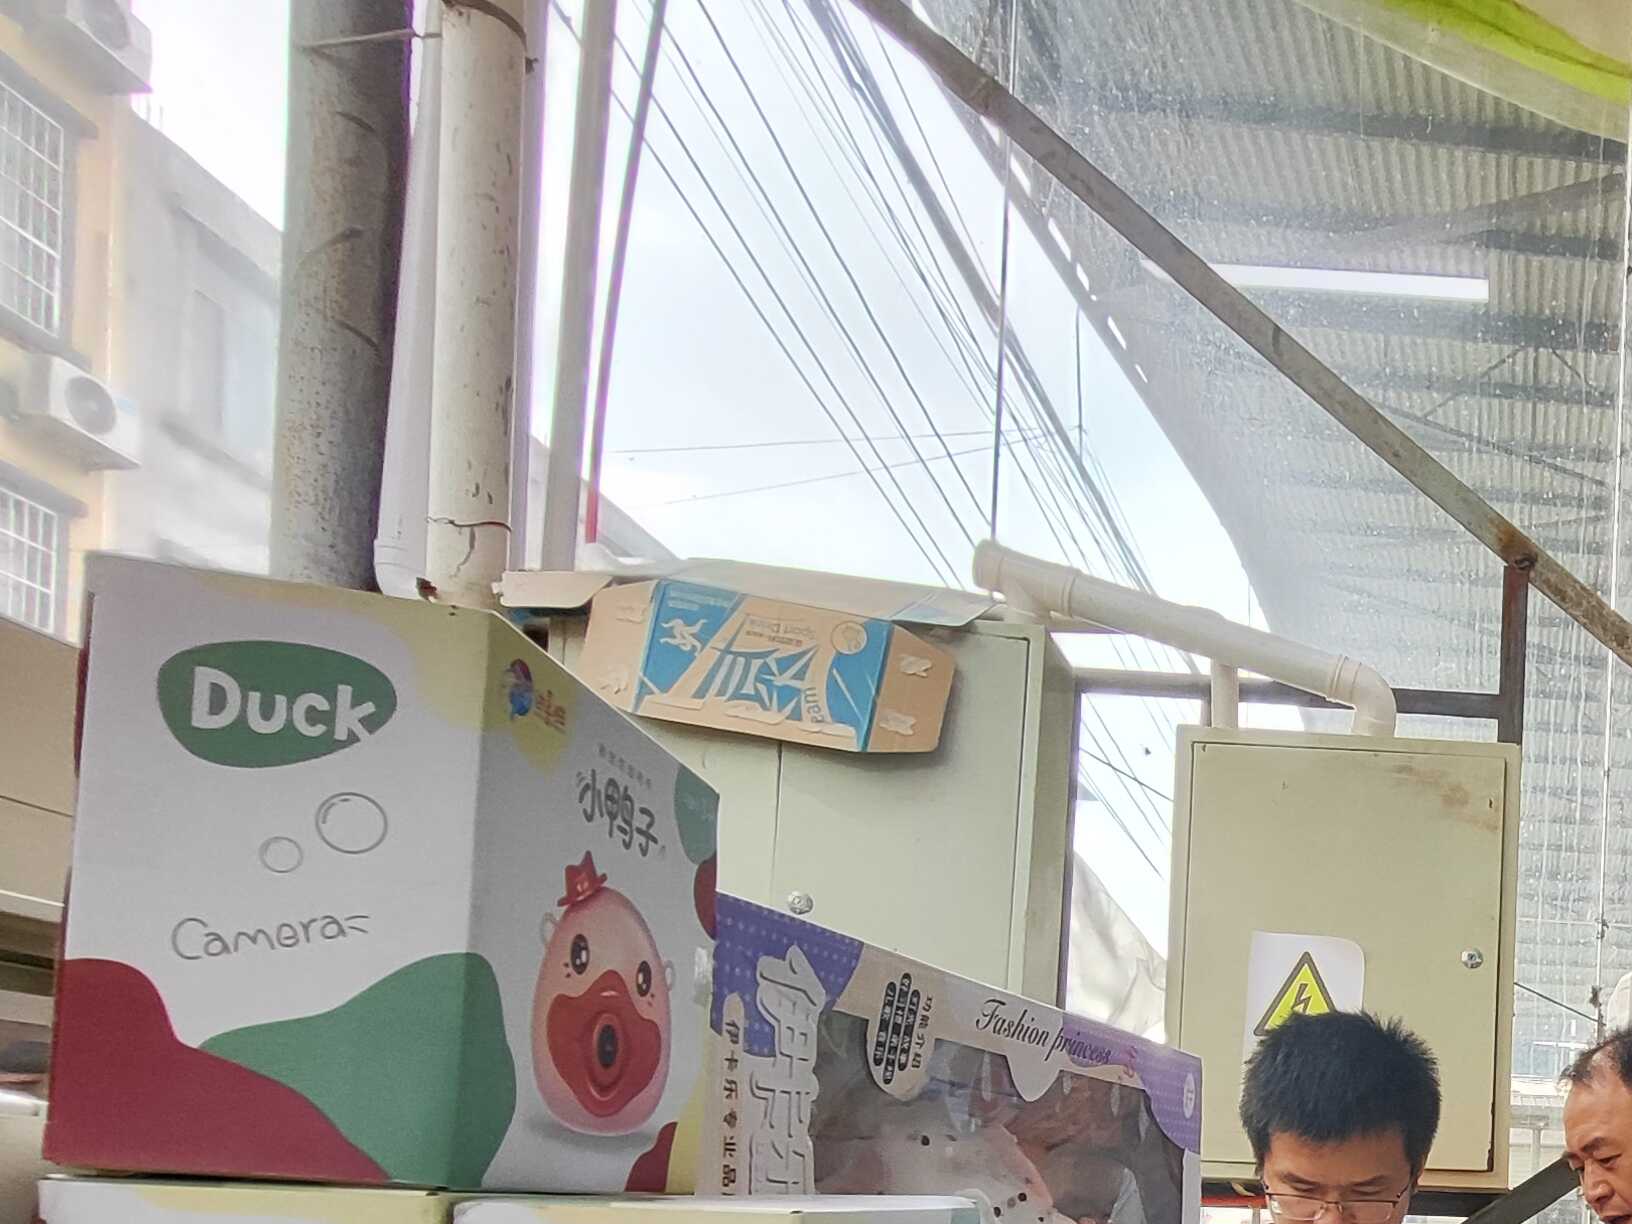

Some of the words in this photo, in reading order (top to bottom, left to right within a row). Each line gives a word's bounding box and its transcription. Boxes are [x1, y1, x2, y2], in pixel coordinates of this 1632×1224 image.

[190, 665, 376, 742] Duck
[577, 768, 659, 857] 小鸭子
[171, 915, 347, 960] Camera
[976, 998, 1050, 1046] Fashion
[1044, 1027, 1112, 1064] princess
[721, 1018, 741, 1196] 伊卡乐专业品
